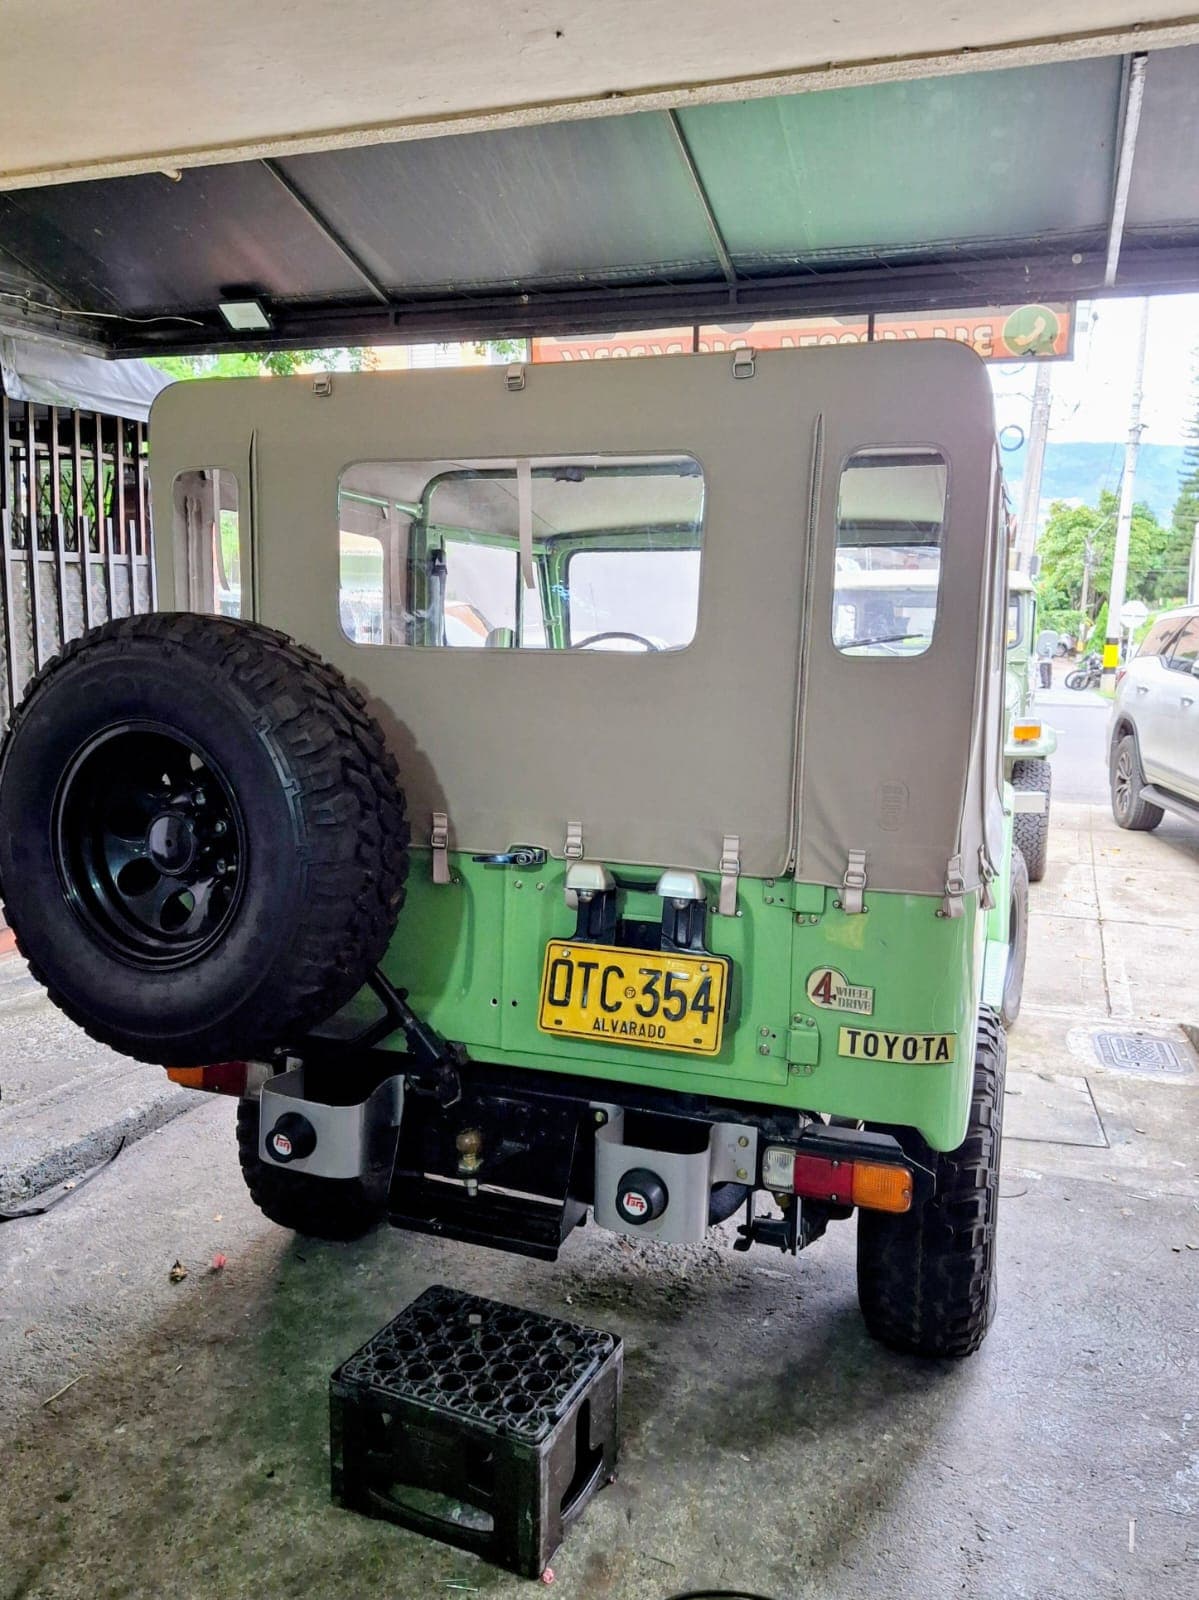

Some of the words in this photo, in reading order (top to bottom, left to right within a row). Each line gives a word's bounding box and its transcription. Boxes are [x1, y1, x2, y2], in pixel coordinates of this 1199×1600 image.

[635, 967, 715, 1025] 354
[811, 971, 837, 1004] 4
[836, 986, 872, 1000] WHEEL
[838, 997, 871, 1011] DRIVE
[592, 1017, 667, 1039] ALVARADO
[847, 1030, 949, 1061] TOYOTA
